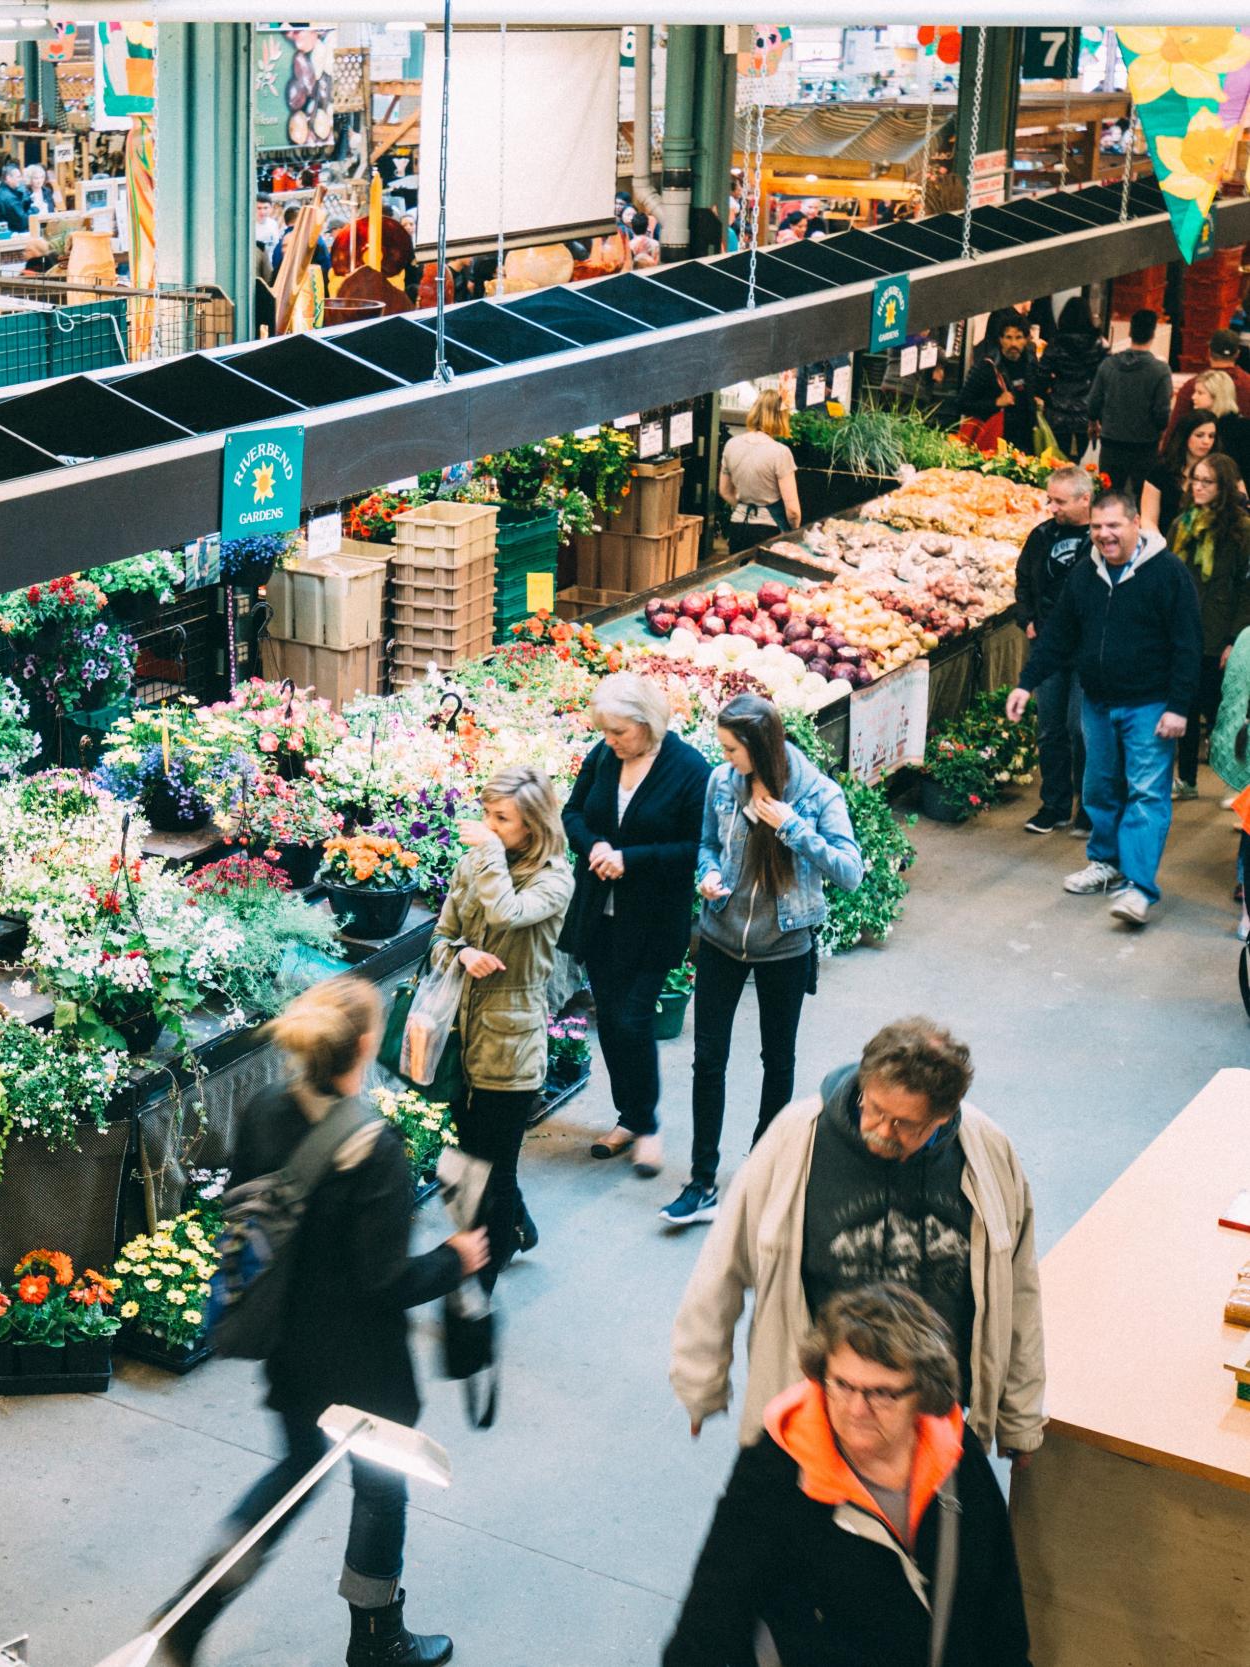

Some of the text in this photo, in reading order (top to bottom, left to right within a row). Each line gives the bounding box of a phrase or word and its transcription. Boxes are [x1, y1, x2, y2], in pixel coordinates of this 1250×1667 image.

[1040, 32, 1067, 67] 7
[233, 442, 294, 488] RIVERBEND
[239, 507, 284, 525] GARDENS
